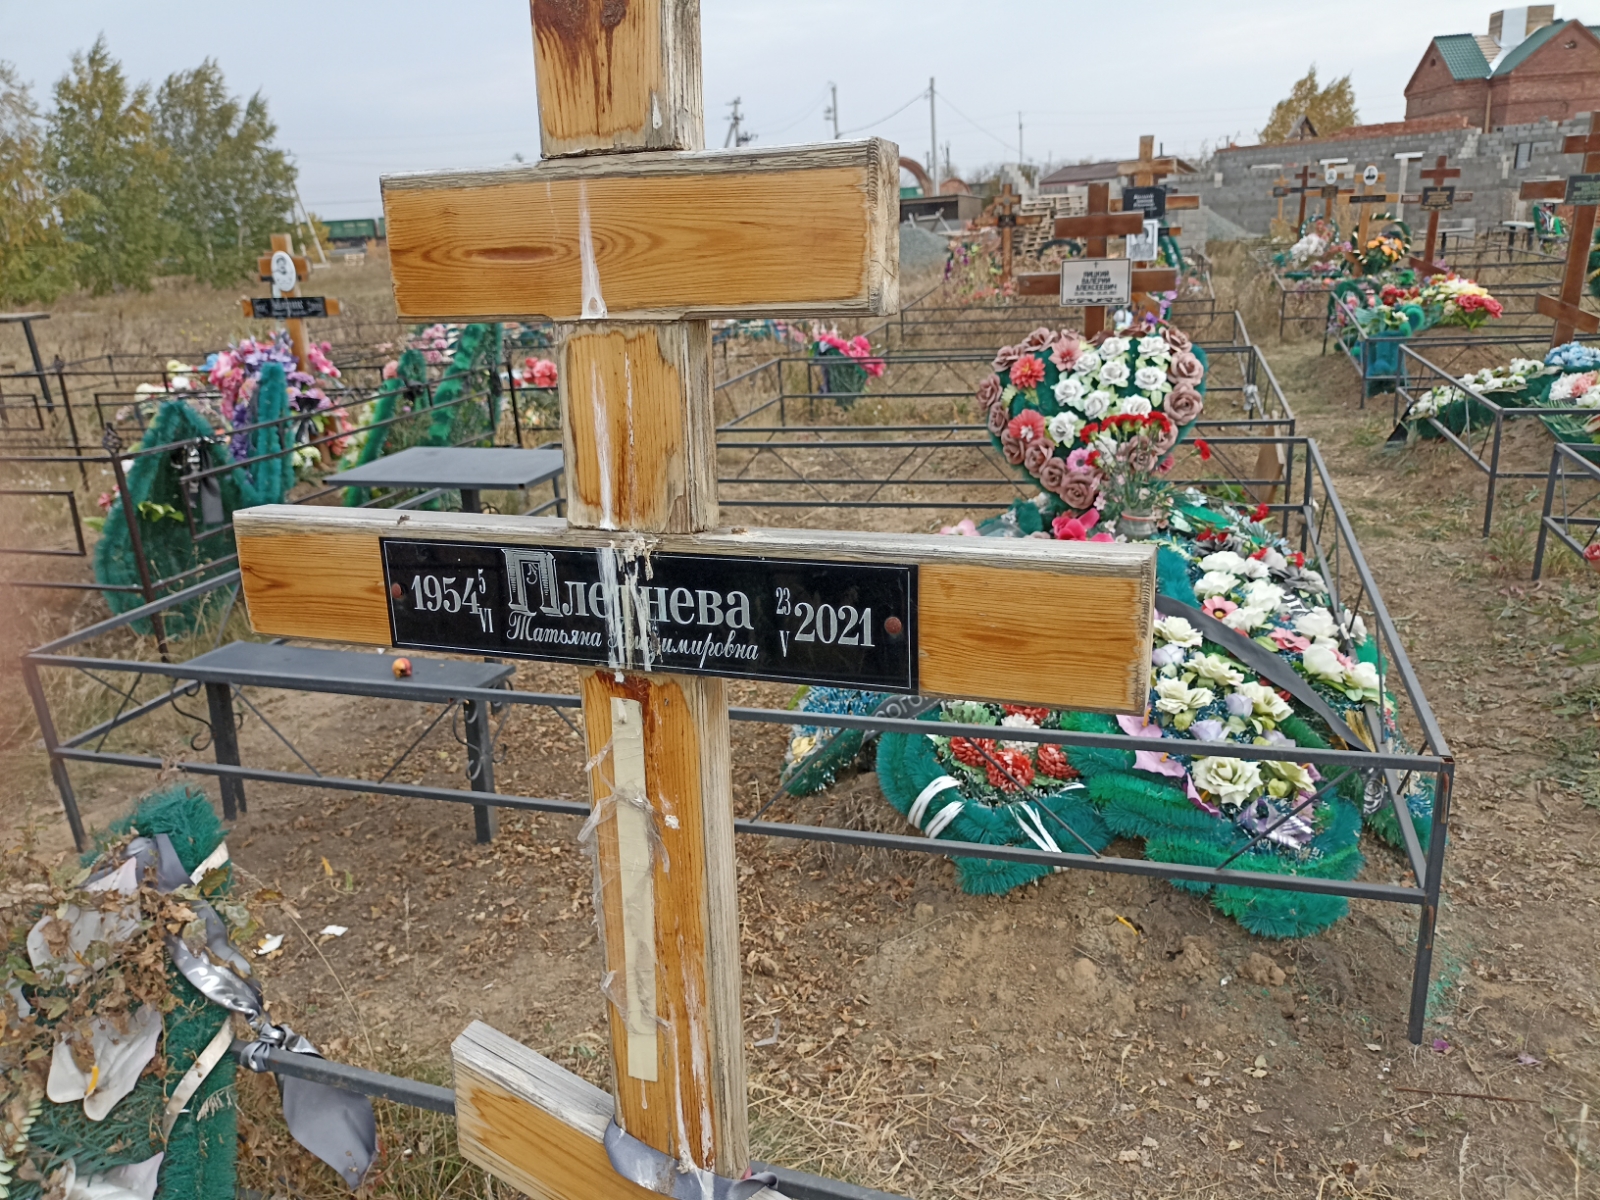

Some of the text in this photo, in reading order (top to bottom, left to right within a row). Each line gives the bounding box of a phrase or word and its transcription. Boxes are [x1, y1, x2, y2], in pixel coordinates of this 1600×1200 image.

[411, 575, 480, 614] 1954
[477, 568, 486, 594] 5
[775, 586, 791, 616] 23
[479, 608, 494, 633] VI
[794, 602, 876, 647] 2021
[506, 610, 758, 669] Татьяна имировна
